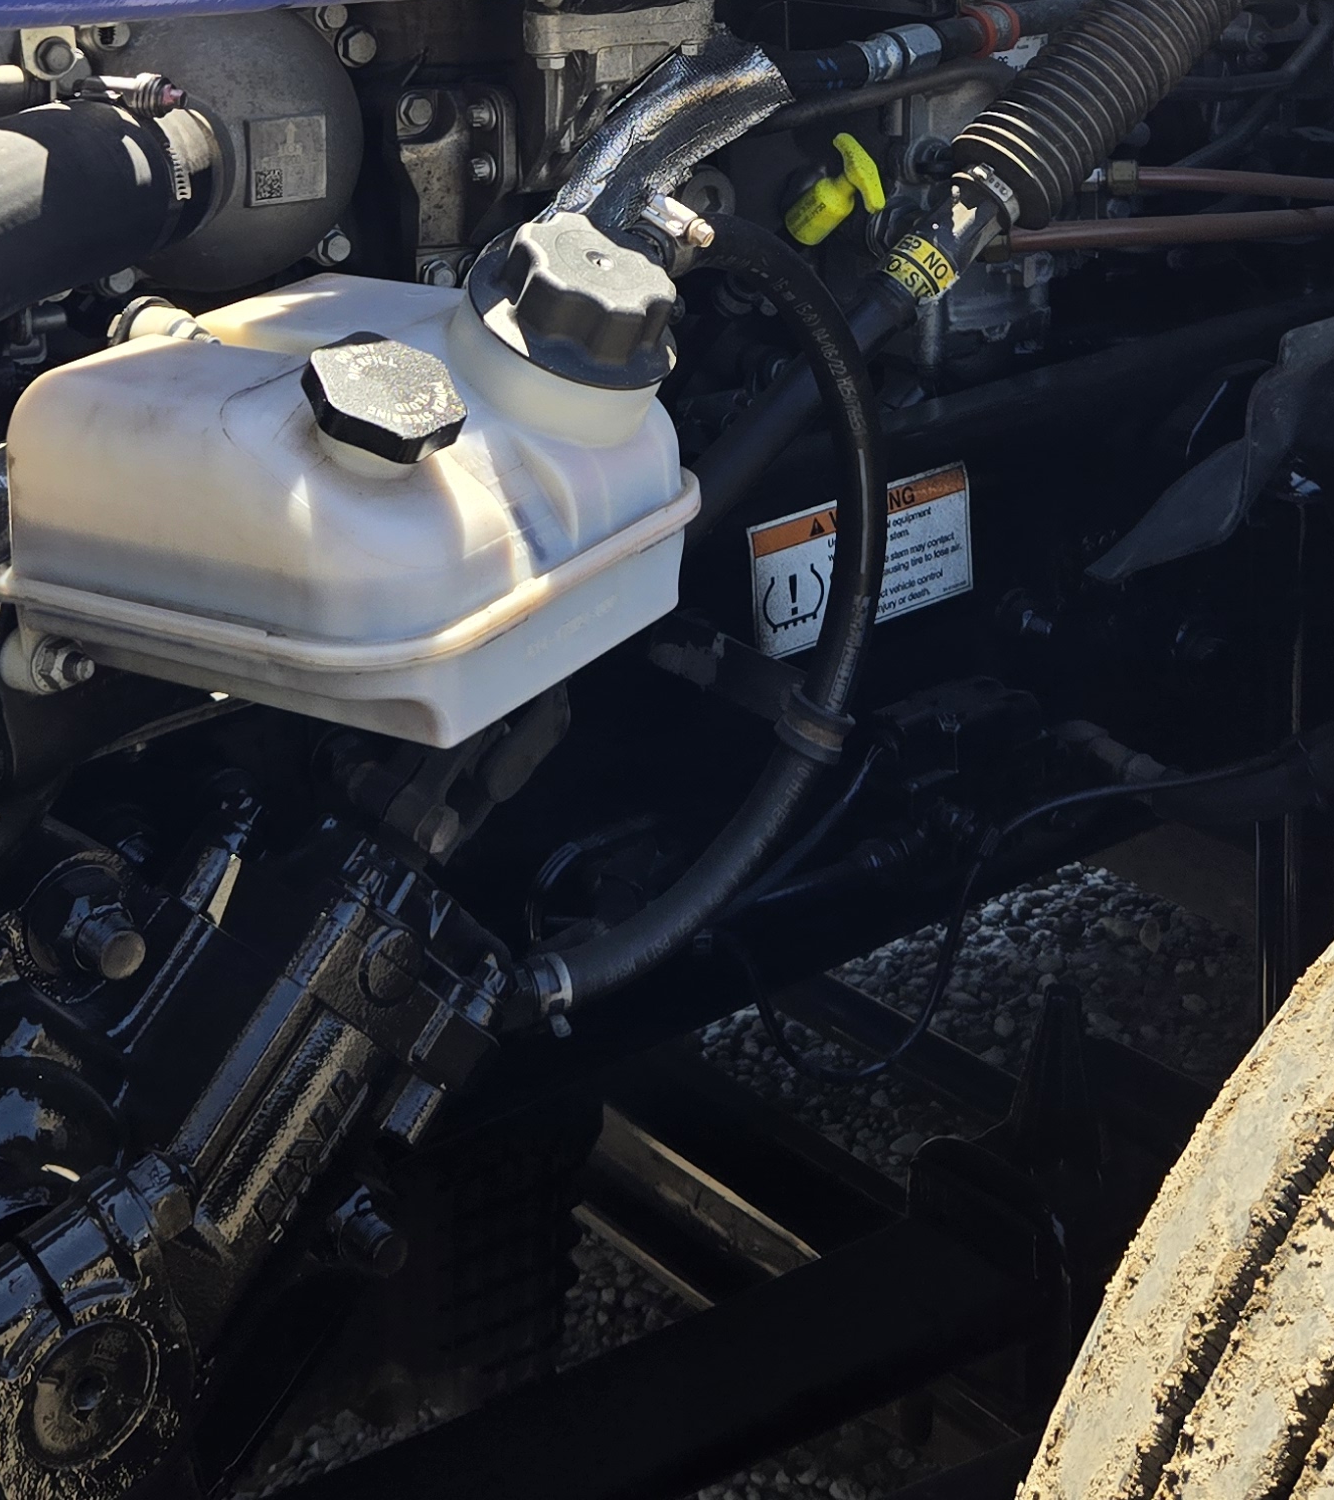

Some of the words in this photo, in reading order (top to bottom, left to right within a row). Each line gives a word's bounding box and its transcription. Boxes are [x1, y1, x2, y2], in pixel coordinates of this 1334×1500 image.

[350, 344, 375, 355] NOT
[347, 355, 399, 380] OVERFILL
[395, 392, 431, 413] FLUID
[431, 381, 448, 413] POWER
[367, 405, 434, 424] STEERING
[892, 506, 932, 527] equipment
[890, 548, 909, 562] stem
[927, 531, 955, 547] contact
[911, 556, 923, 567] tire
[924, 553, 933, 562] to
[889, 579, 916, 596] vehicle
[916, 569, 944, 585] control
